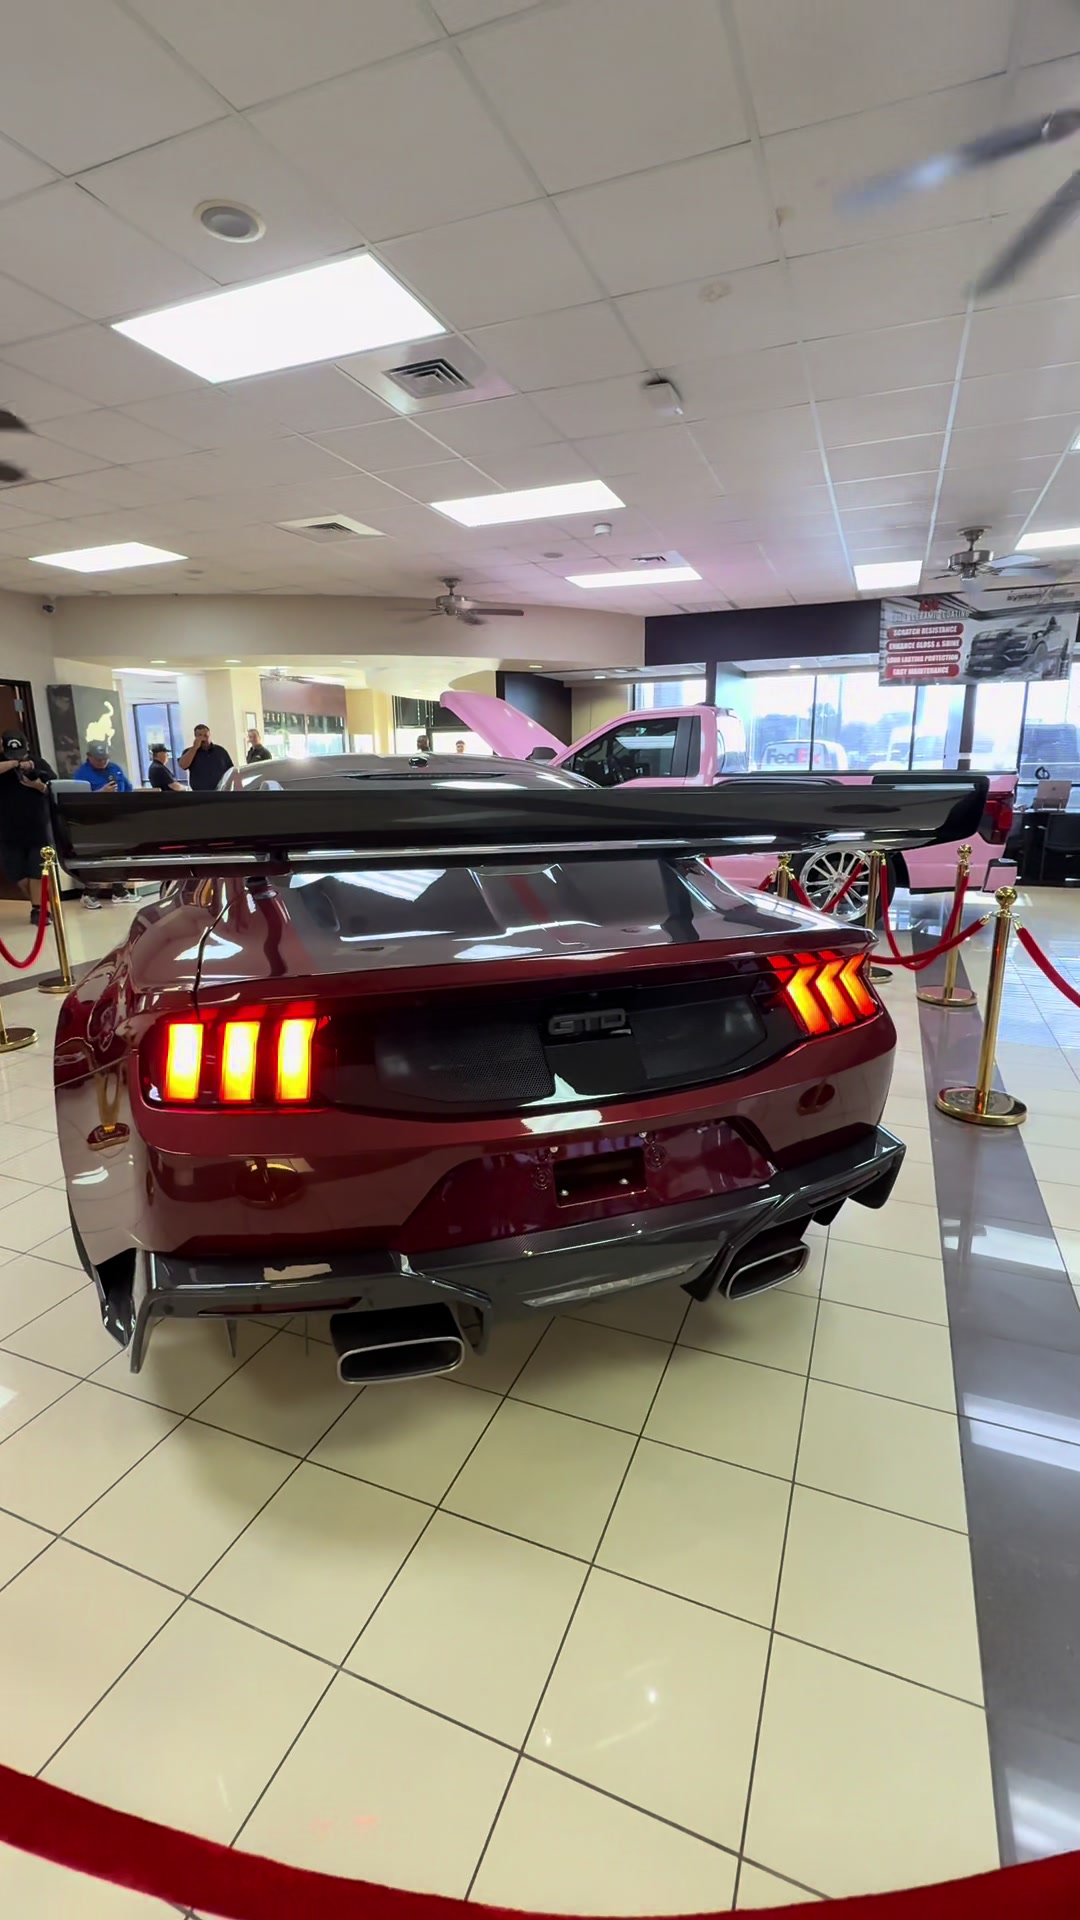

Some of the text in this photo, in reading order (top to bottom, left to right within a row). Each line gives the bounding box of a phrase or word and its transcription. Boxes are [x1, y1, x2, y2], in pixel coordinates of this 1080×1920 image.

[943, 609, 969, 619] COATING
[893, 625, 957, 636] SCRATCH RESISTANCE
[889, 641, 915, 650] ENHANCE
[916, 641, 935, 649] GLOSS
[886, 654, 958, 664] LONG LASTING PROTECTION
[892, 666, 949, 676] EASY MAINTENANCE
[766, 748, 821, 765] FedEx
[548, 1008, 626, 1035] GTD
